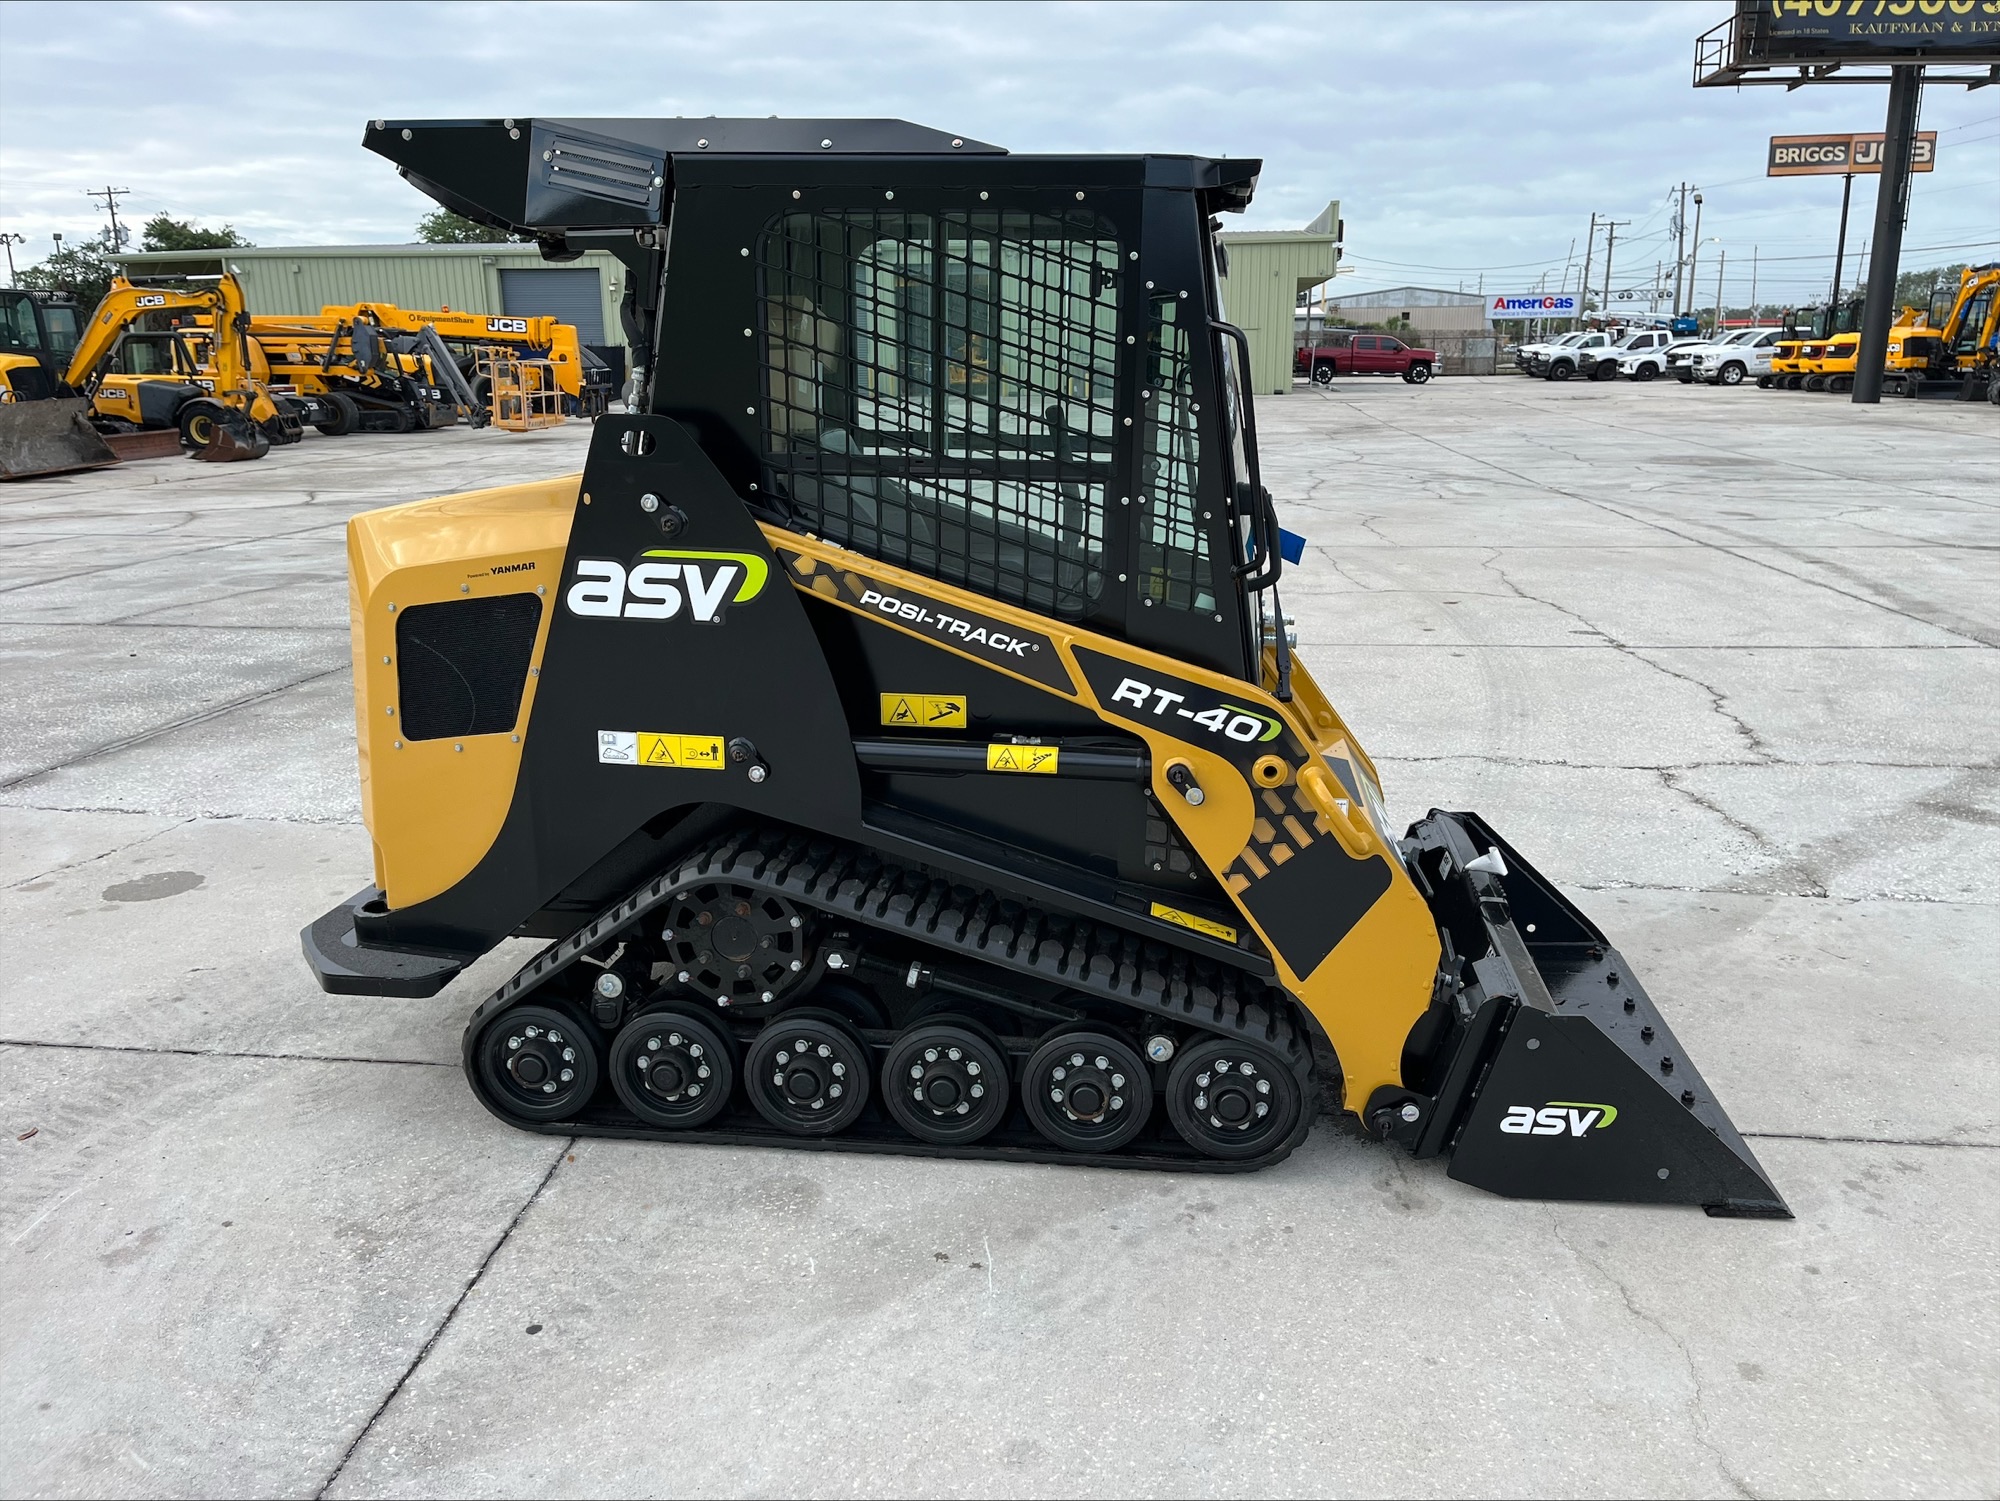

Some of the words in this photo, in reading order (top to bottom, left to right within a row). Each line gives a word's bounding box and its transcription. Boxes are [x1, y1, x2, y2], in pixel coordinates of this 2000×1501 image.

[1848, 22, 1945, 34] KAUFMAN
[1951, 22, 1963, 33] &
[1775, 145, 1846, 164] BRIGGS
[1856, 141, 1931, 163] JB
[136, 295, 166, 307] JCB
[1493, 296, 1574, 310] AmeriGas
[416, 314, 475, 324] EquipmentShare
[1545, 309, 1573, 317] Company
[487, 318, 527, 333] JCB
[99, 389, 127, 398] JCB
[490, 562, 536, 575] YANMAR
[1111, 677, 1263, 742] RT-40
